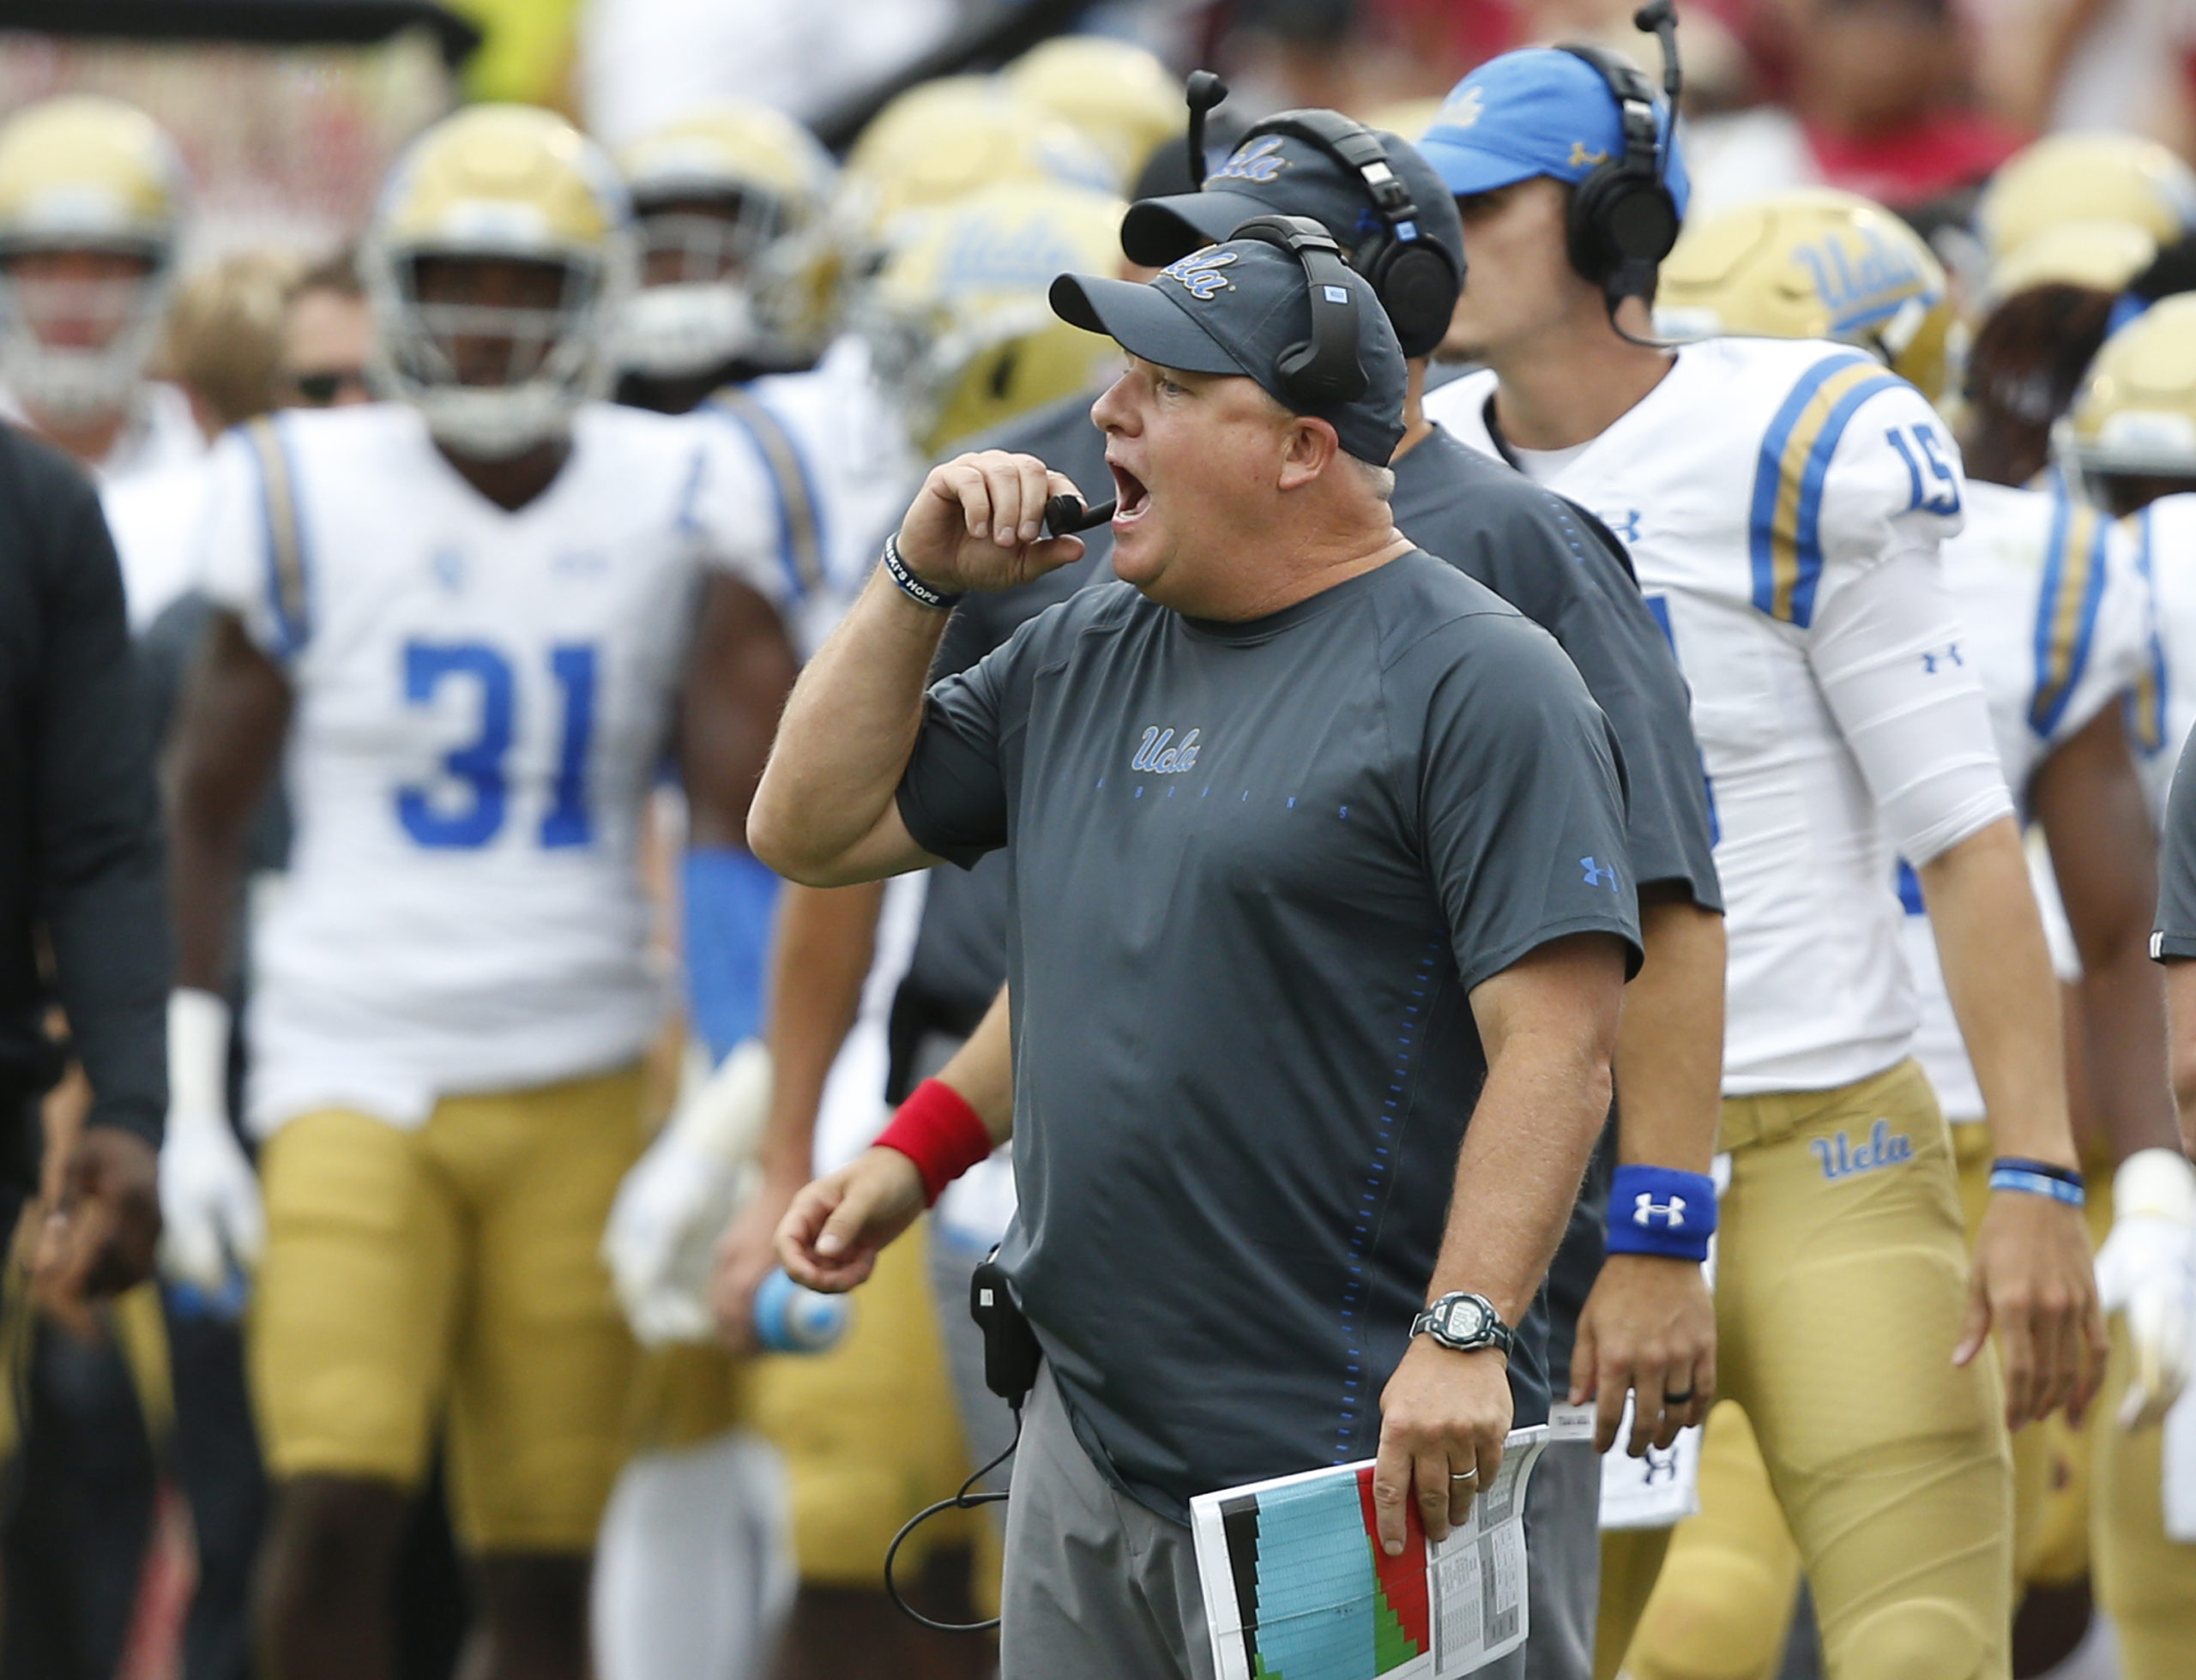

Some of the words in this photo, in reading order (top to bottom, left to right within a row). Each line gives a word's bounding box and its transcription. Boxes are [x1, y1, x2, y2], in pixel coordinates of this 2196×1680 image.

[1885, 423, 1961, 516] 15
[906, 579, 940, 604] HOPE
[398, 639, 594, 849] 31
[1131, 725, 1201, 774] Ucla
[1809, 1117, 1913, 1181] Ucla
